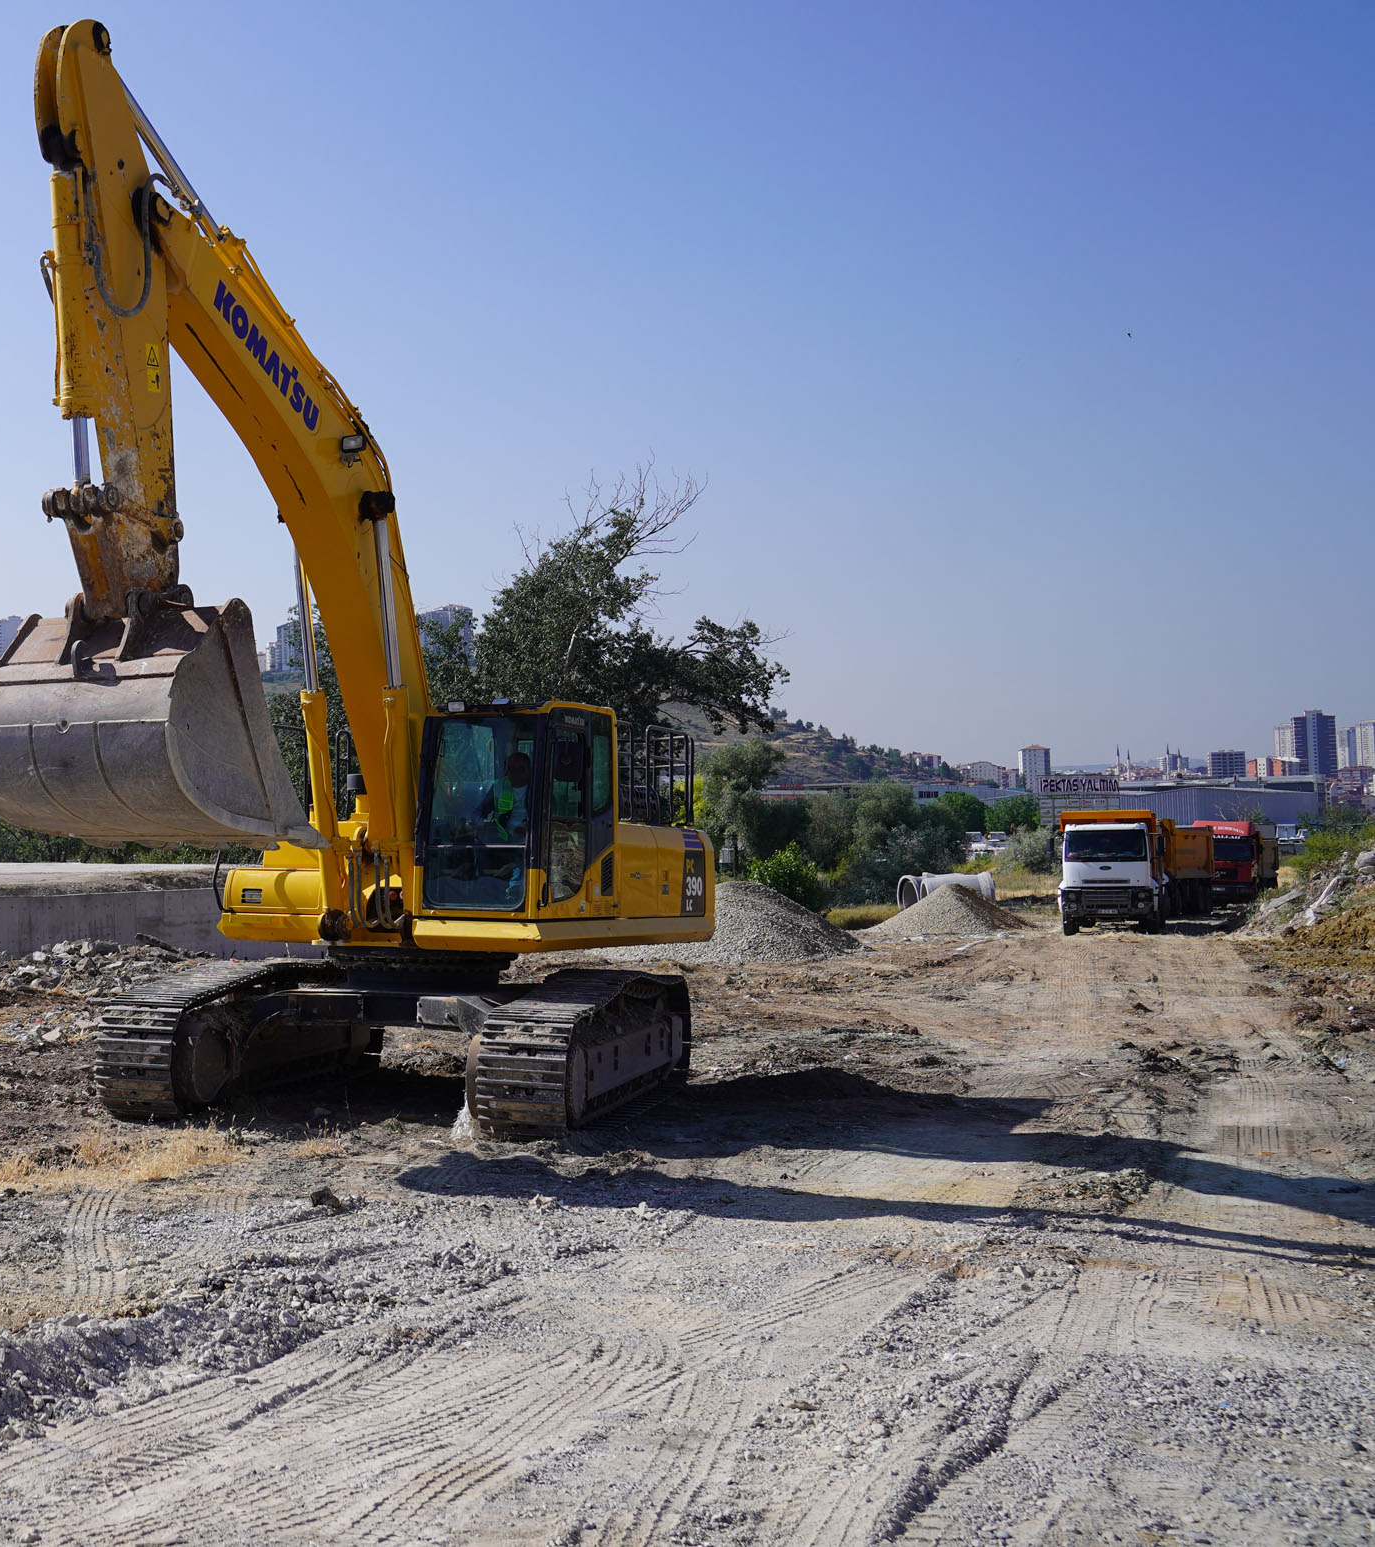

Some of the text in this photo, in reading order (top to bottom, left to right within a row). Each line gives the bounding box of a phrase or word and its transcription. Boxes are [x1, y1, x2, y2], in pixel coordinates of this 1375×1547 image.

[212, 279, 320, 432] KOMATSU
[685, 858, 695, 873] PC
[685, 876, 703, 897] 390
[685, 899, 693, 912] LC
